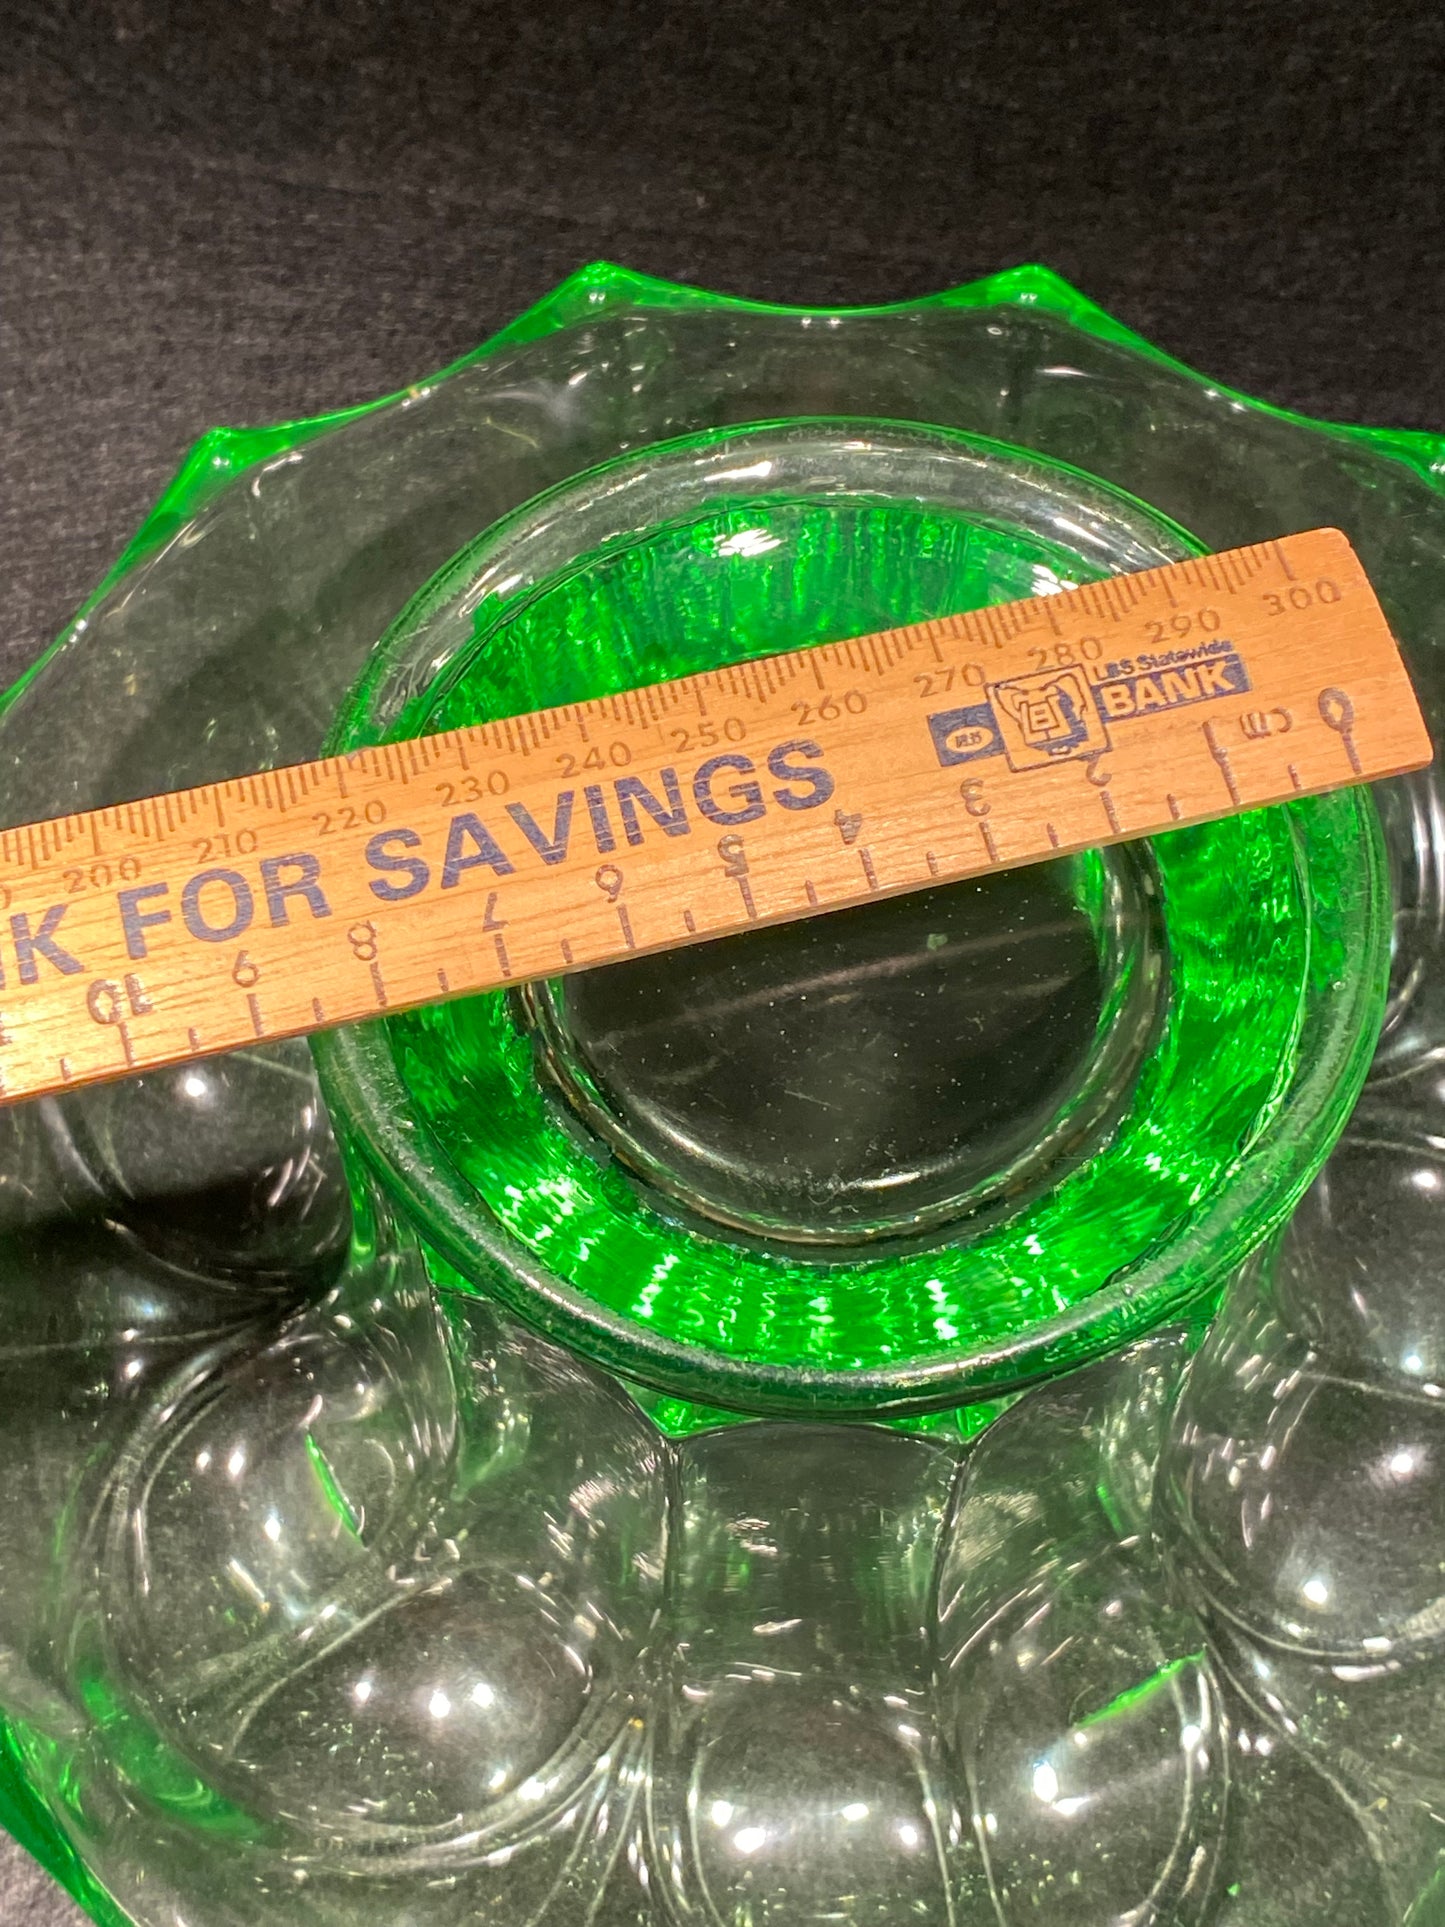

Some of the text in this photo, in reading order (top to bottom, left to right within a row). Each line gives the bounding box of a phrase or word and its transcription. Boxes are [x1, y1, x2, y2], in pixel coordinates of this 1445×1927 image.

[1100, 660, 1237, 717] BANK
[62, 579, 1342, 894] 200 210 220 230 240 250 260 270 280 290 300
[959, 777, 991, 817] 3
[117, 851, 333, 961] FOR
[363, 738, 836, 902] SAVINGS
[347, 920, 377, 961] 8
